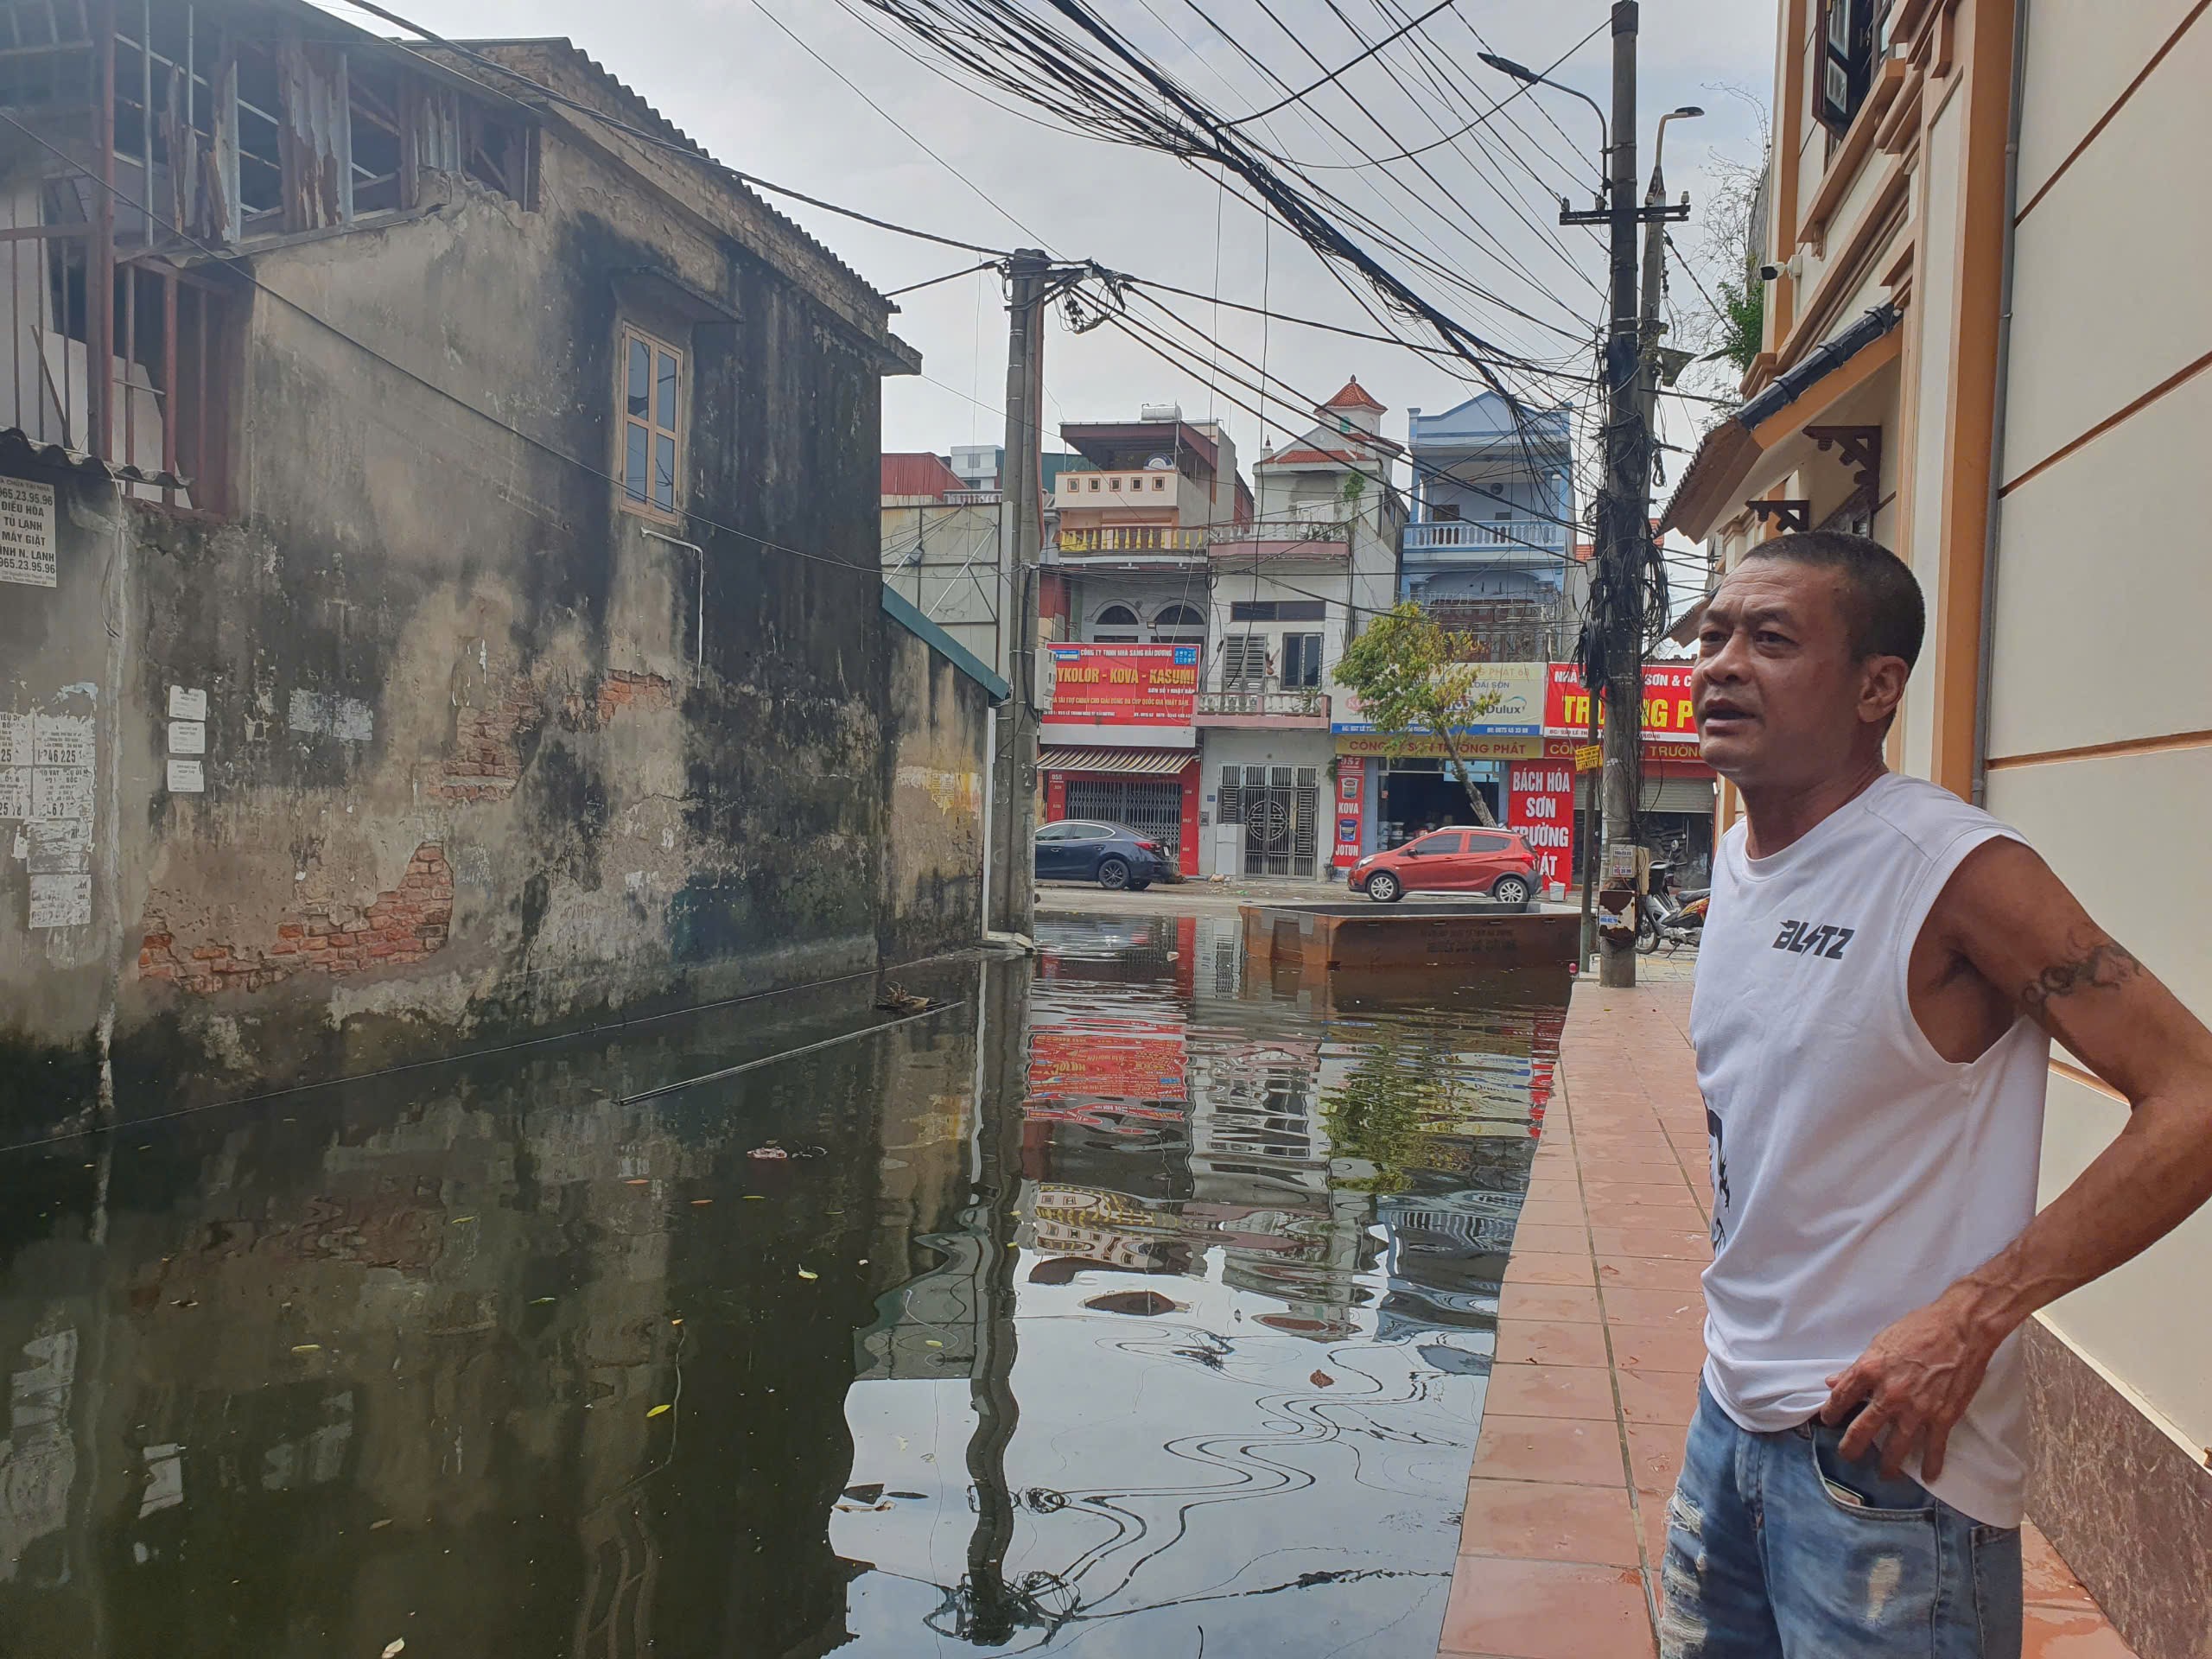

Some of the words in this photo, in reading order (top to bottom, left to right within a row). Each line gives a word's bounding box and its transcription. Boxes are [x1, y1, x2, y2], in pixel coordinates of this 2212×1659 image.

[19, 518, 42, 531] LẠNH
[2, 530, 22, 543] MÁY
[31, 550, 54, 563] LẠNH
[1080, 648, 1095, 657] CÔNG
[1129, 649, 1144, 658] SANG
[1056, 668, 1099, 683] YKOLOR
[1109, 669, 1139, 684] KOVA
[1554, 671, 1577, 683] NHÀ
[1644, 673, 1669, 686] SƠN
[1671, 675, 1681, 687] &
[1486, 704, 1521, 714] Dulux
[1649, 743, 1701, 758] TRƯỜN
[1513, 767, 1543, 792] BÁCH
[1547, 767, 1570, 792] HÓA
[1338, 802, 1359, 814] KOVA
[1526, 796, 1556, 818] SƠN
[1335, 844, 1359, 856] JOTUN
